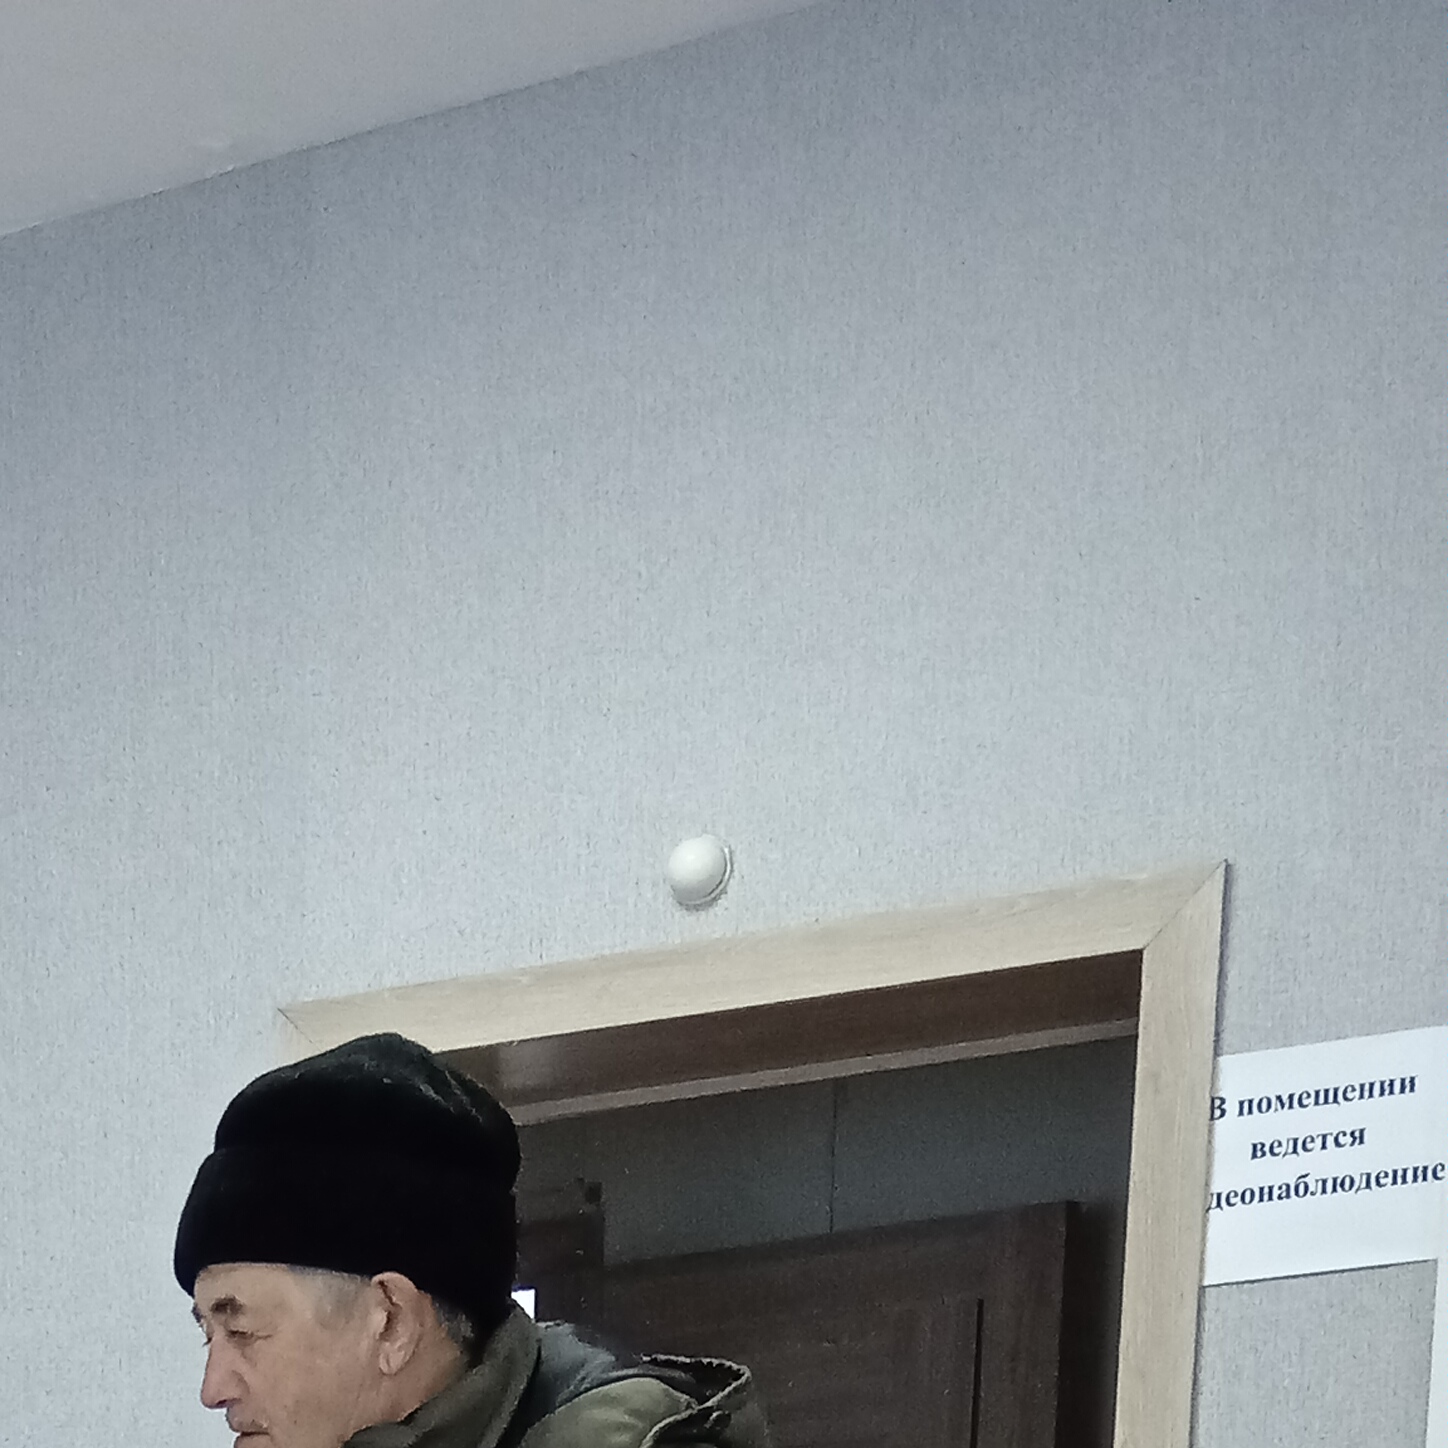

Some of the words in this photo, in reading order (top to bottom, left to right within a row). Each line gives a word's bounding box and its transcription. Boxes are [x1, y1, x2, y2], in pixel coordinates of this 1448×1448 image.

[1209, 1096, 1226, 1121] В
[1237, 1075, 1418, 1117] помещении
[1250, 1128, 1366, 1160] ведется
[1206, 1162, 1446, 1213] деонаблюдение
